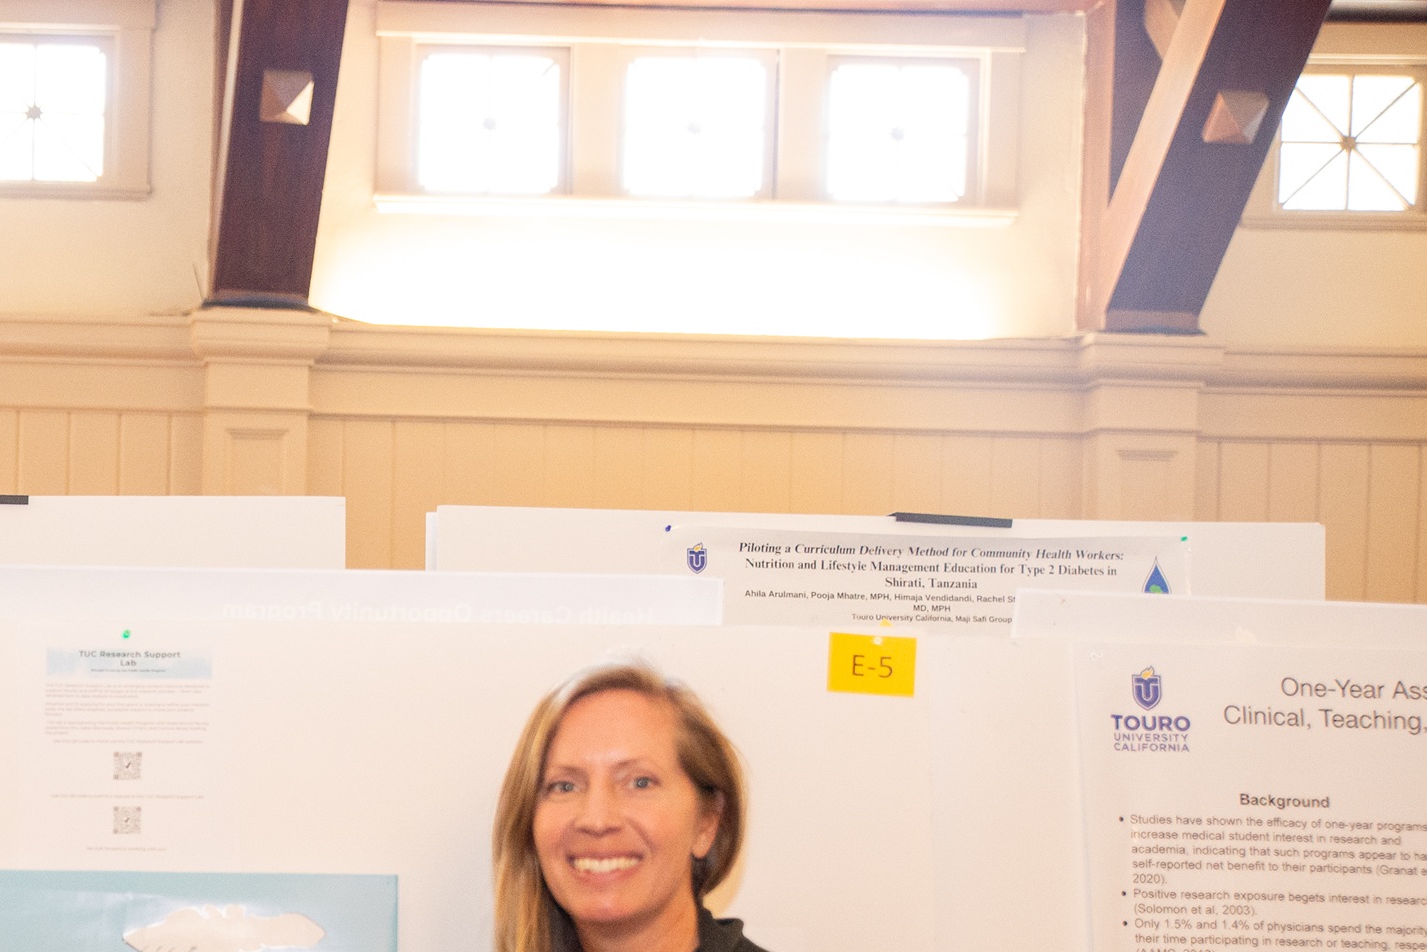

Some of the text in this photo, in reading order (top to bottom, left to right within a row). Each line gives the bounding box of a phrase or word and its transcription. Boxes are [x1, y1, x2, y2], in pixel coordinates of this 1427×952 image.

[739, 542, 1125, 561] Piloting a Curriculum Delivery Method for Community Health Workers:
[745, 558, 1117, 577] Nutrition and Lifestyle Management Education for Type 2 Diabetes in
[885, 576, 977, 589] Shirati, Tanzania
[768, 590, 807, 599] Arulmani,
[810, 591, 834, 601] Pooja
[836, 592, 867, 600] Mhatre,
[869, 592, 891, 601] MPH,
[893, 593, 922, 603] Himaja
[925, 593, 973, 603] Vendidandi,
[975, 595, 1005, 603] Rachel
[913, 604, 951, 613] MD, MPH
[875, 614, 913, 623] University
[955, 615, 970, 625] Maji
[988, 616, 1013, 625] Group
[99, 651, 141, 659] Research
[144, 651, 181, 660] Support
[120, 659, 137, 667] Lab
[852, 654, 893, 678] E-5
[1281, 677, 1384, 699] One-Year
[1110, 714, 1191, 732] TOURO
[1223, 704, 1311, 731] Clinical,
[1113, 732, 1189, 743] UNIVERSITY
[1113, 742, 1190, 753] CALIFORNIA
[1239, 793, 1330, 811] Background
[1129, 814, 1172, 825] Studies
[1175, 815, 1202, 825] have
[1206, 816, 1242, 826] shown
[1245, 817, 1263, 827] the
[1266, 817, 1307, 831] efficacy
[1311, 819, 1321, 828] of
[1324, 821, 1372, 832] one-year
[1130, 829, 1402, 845] increase medical student interest in research and
[1192, 845, 1246, 858] indicating
[1249, 846, 1270, 856] that
[1273, 847, 1299, 857] such
[1303, 850, 1355, 860] programs
[1358, 851, 1396, 861] appear
[1399, 849, 1411, 859] to
[1132, 859, 1417, 878] self-reported net benefit to their participants (Granat
[1132, 873, 1168, 884] 2020).
[1133, 888, 1383, 905] Positive research exposure begets interest in
[1133, 904, 1187, 917] (Solomon
[1190, 904, 1201, 914] et
[1222, 905, 1257, 918] 2003).
[1135, 919, 1381, 935] Only 1.5% and 1.4% of physicians spend the
